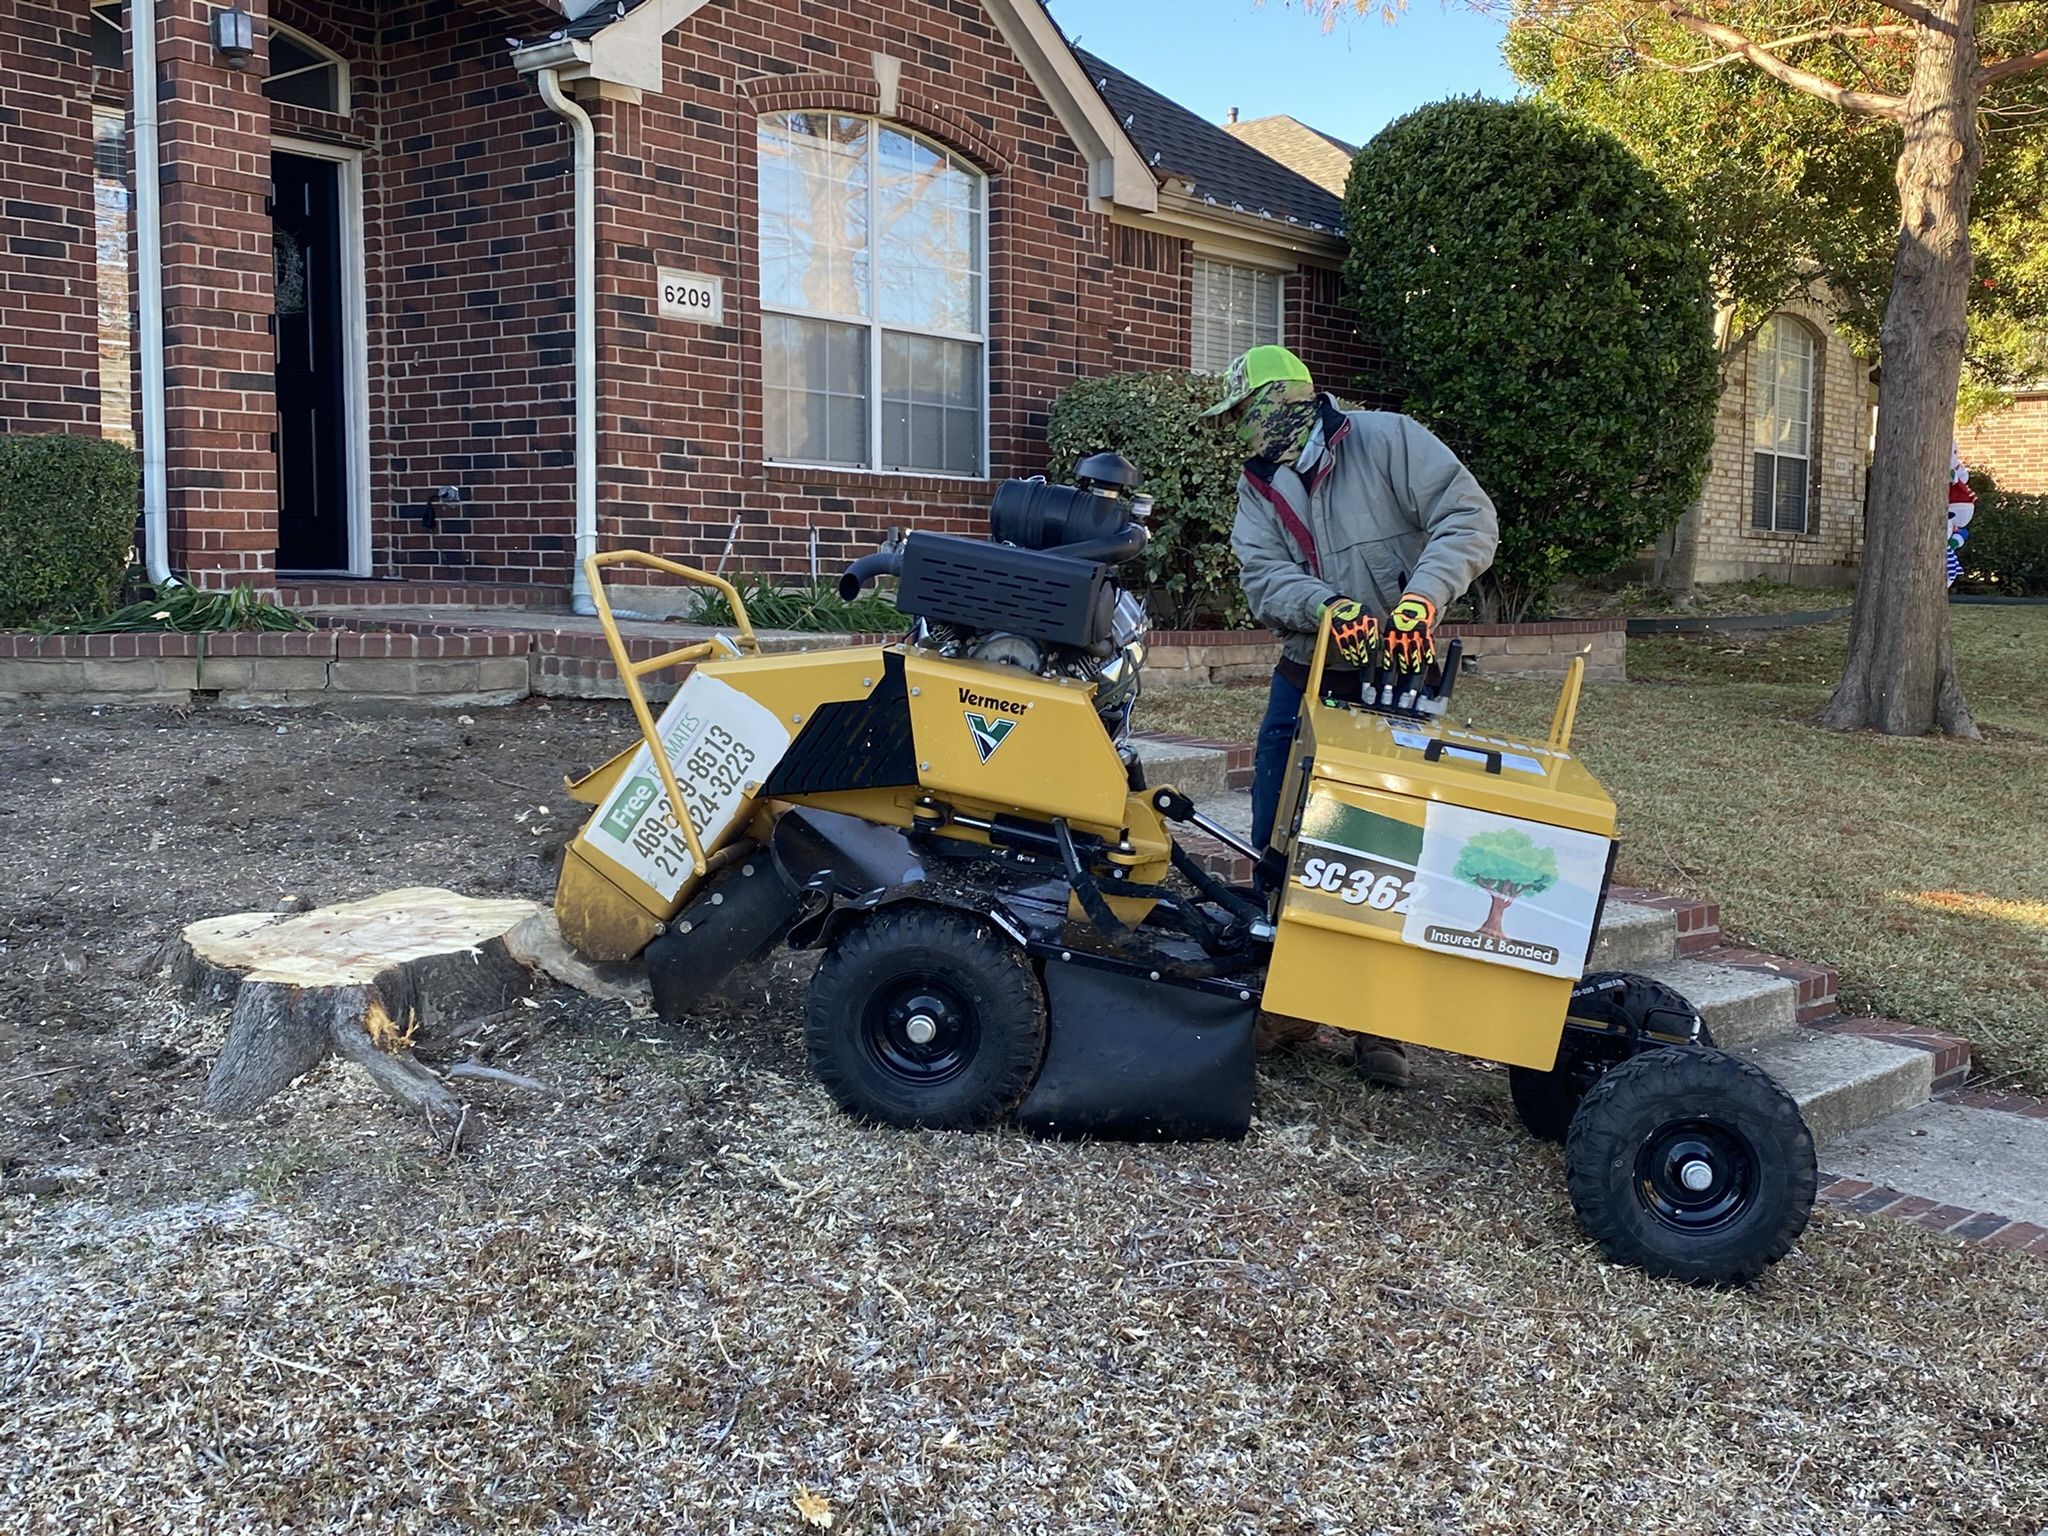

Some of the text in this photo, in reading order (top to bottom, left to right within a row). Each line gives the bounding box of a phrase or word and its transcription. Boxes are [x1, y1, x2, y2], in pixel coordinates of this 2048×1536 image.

[665, 285, 711, 308] 6209
[958, 687, 1028, 715] Vermeer
[609, 712, 700, 830] Free EIMATES
[632, 724, 733, 859] 469-29-8513
[1430, 929, 1553, 962] Insured & Bonded
